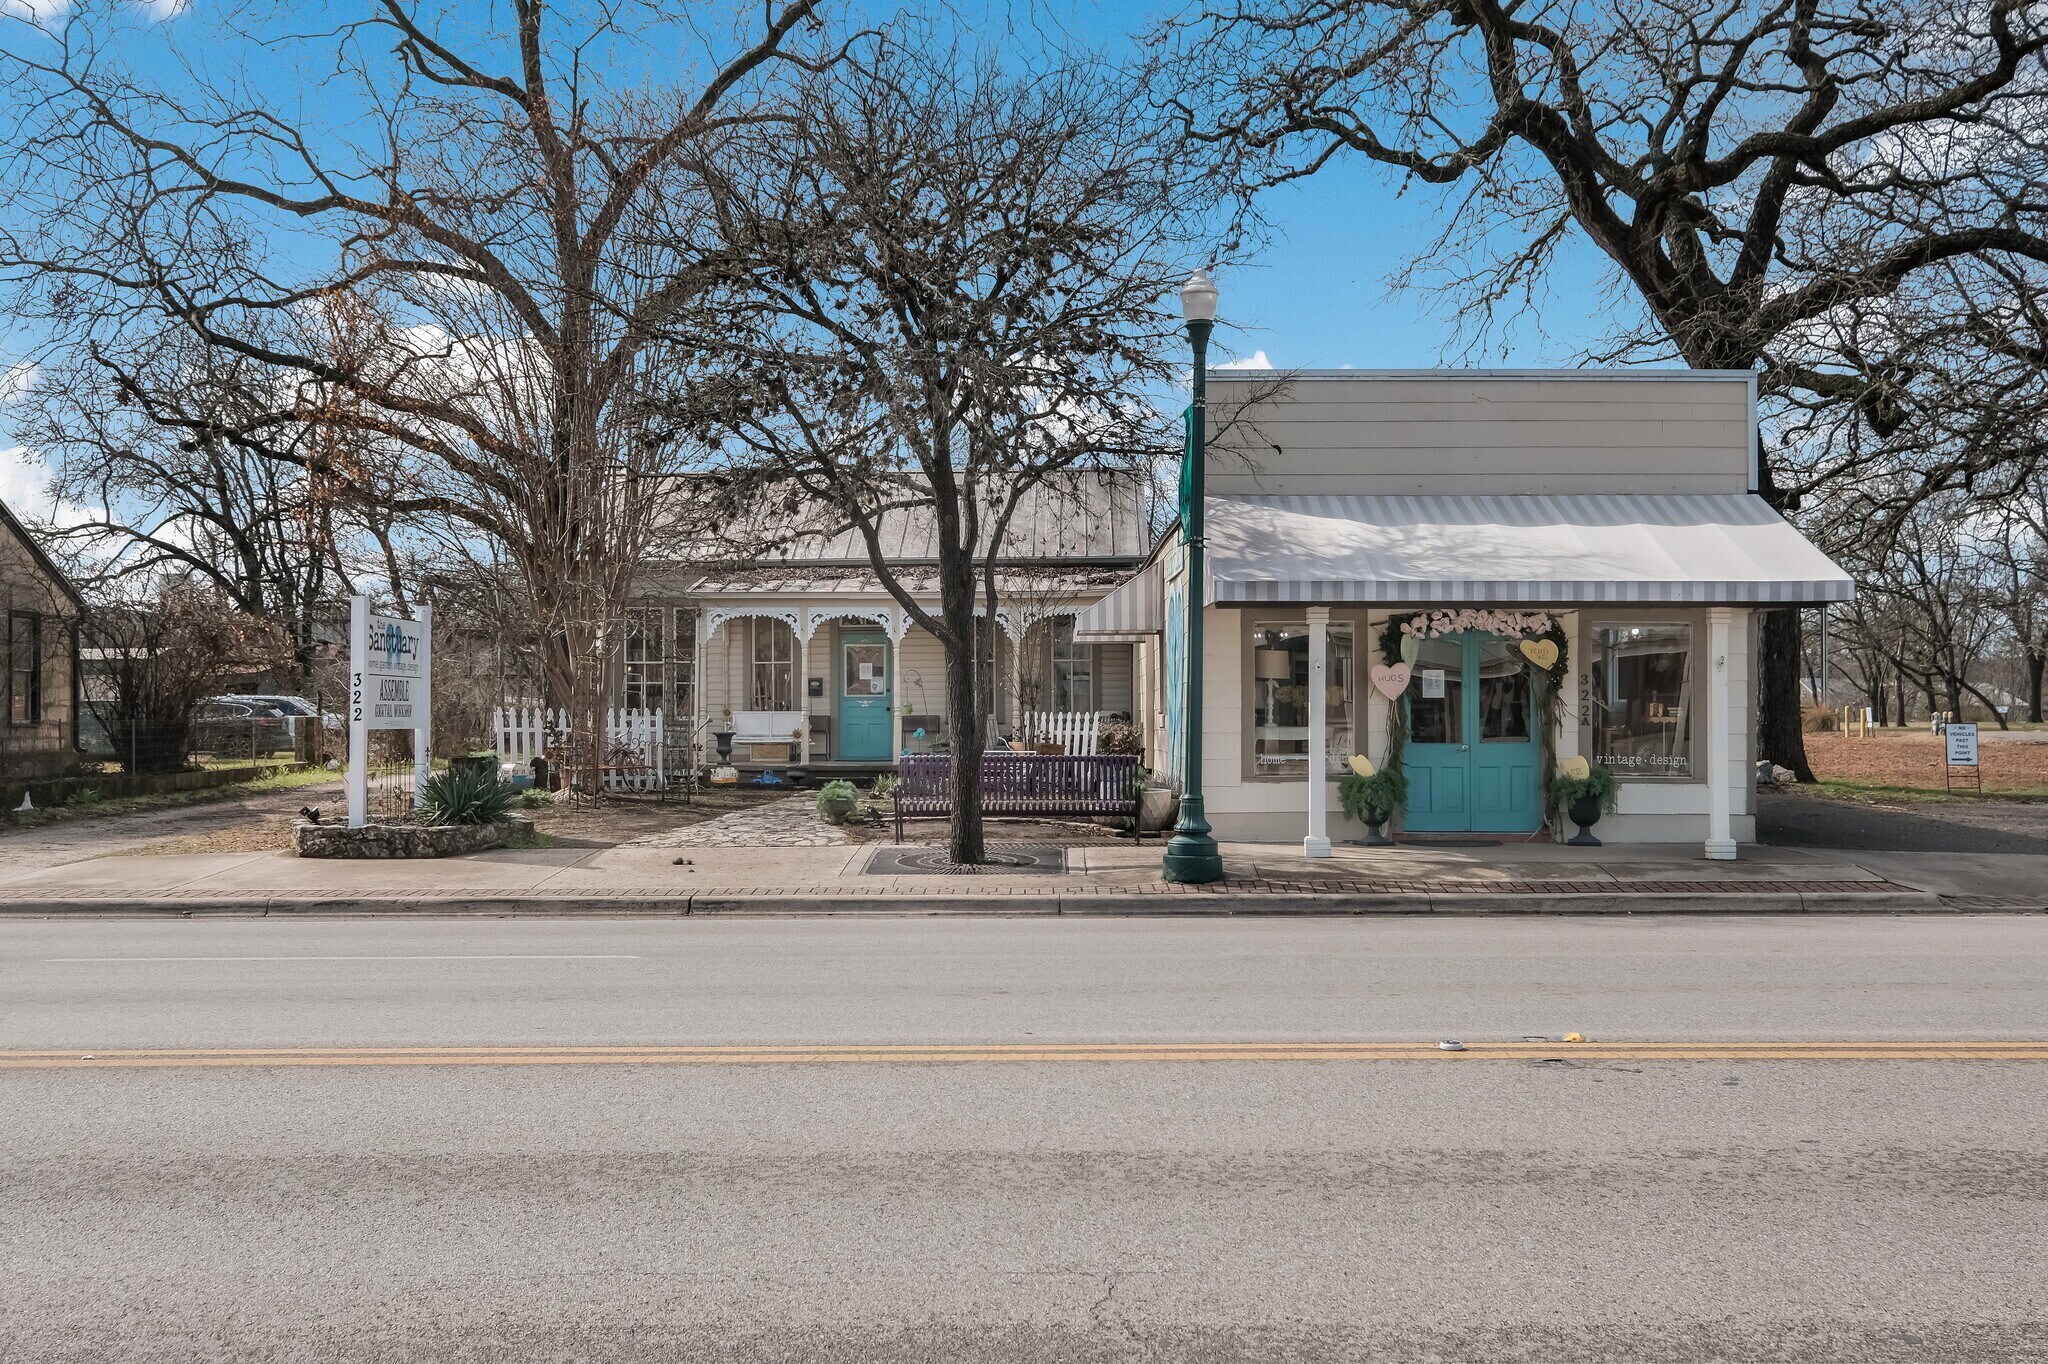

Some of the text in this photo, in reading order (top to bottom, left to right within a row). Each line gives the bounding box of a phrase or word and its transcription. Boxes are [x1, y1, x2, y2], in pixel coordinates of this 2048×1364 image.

[377, 619, 386, 630] the
[369, 624, 419, 660] Sanctuary
[1378, 674, 1404, 683] HUGS
[380, 679, 409, 701] ASSEMBLE
[1260, 753, 1286, 765] home
